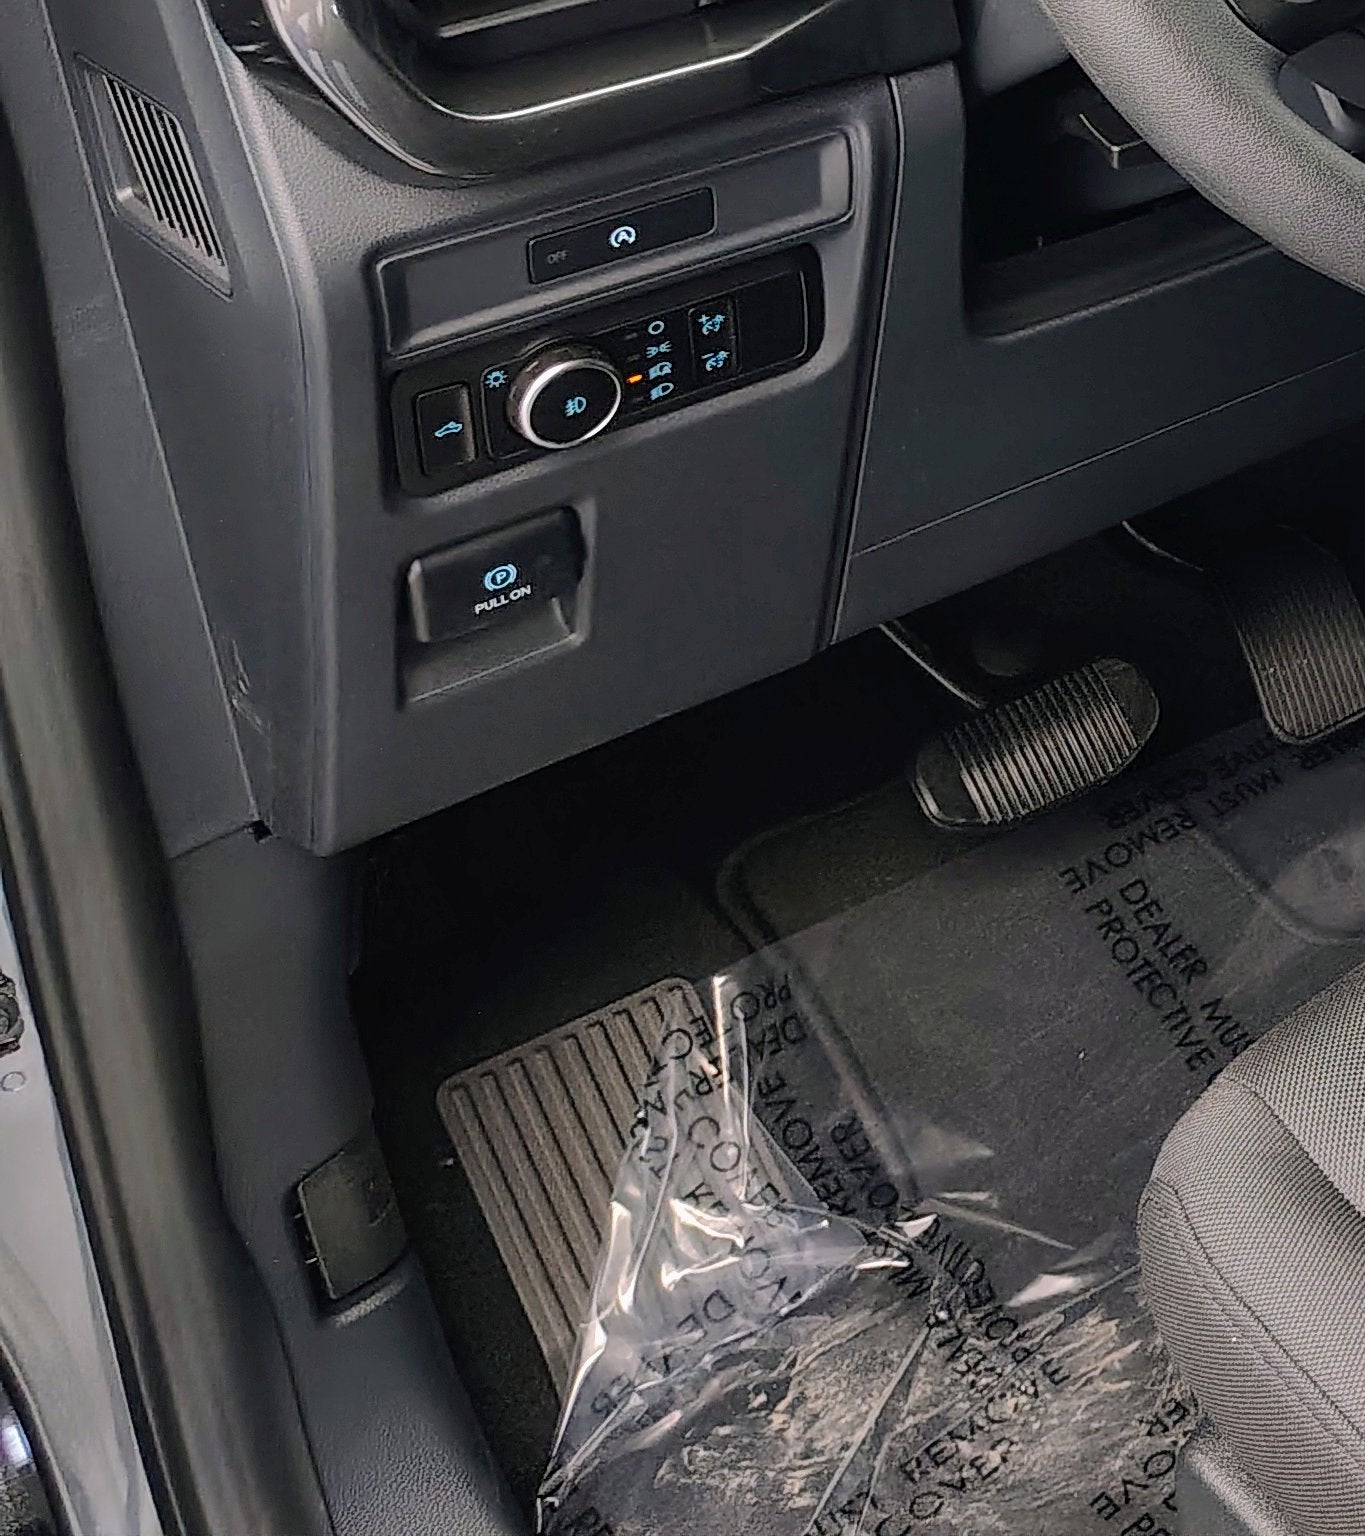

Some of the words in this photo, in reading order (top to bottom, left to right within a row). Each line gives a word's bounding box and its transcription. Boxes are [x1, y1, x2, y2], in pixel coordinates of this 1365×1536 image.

[547, 249, 569, 264] OFF
[474, 594, 509, 615] PULL
[509, 584, 532, 600] ON
[1059, 808, 1198, 895] REMOVE
[1119, 877, 1208, 984] DEALER
[1085, 898, 1217, 1073] PROTECTIVE
